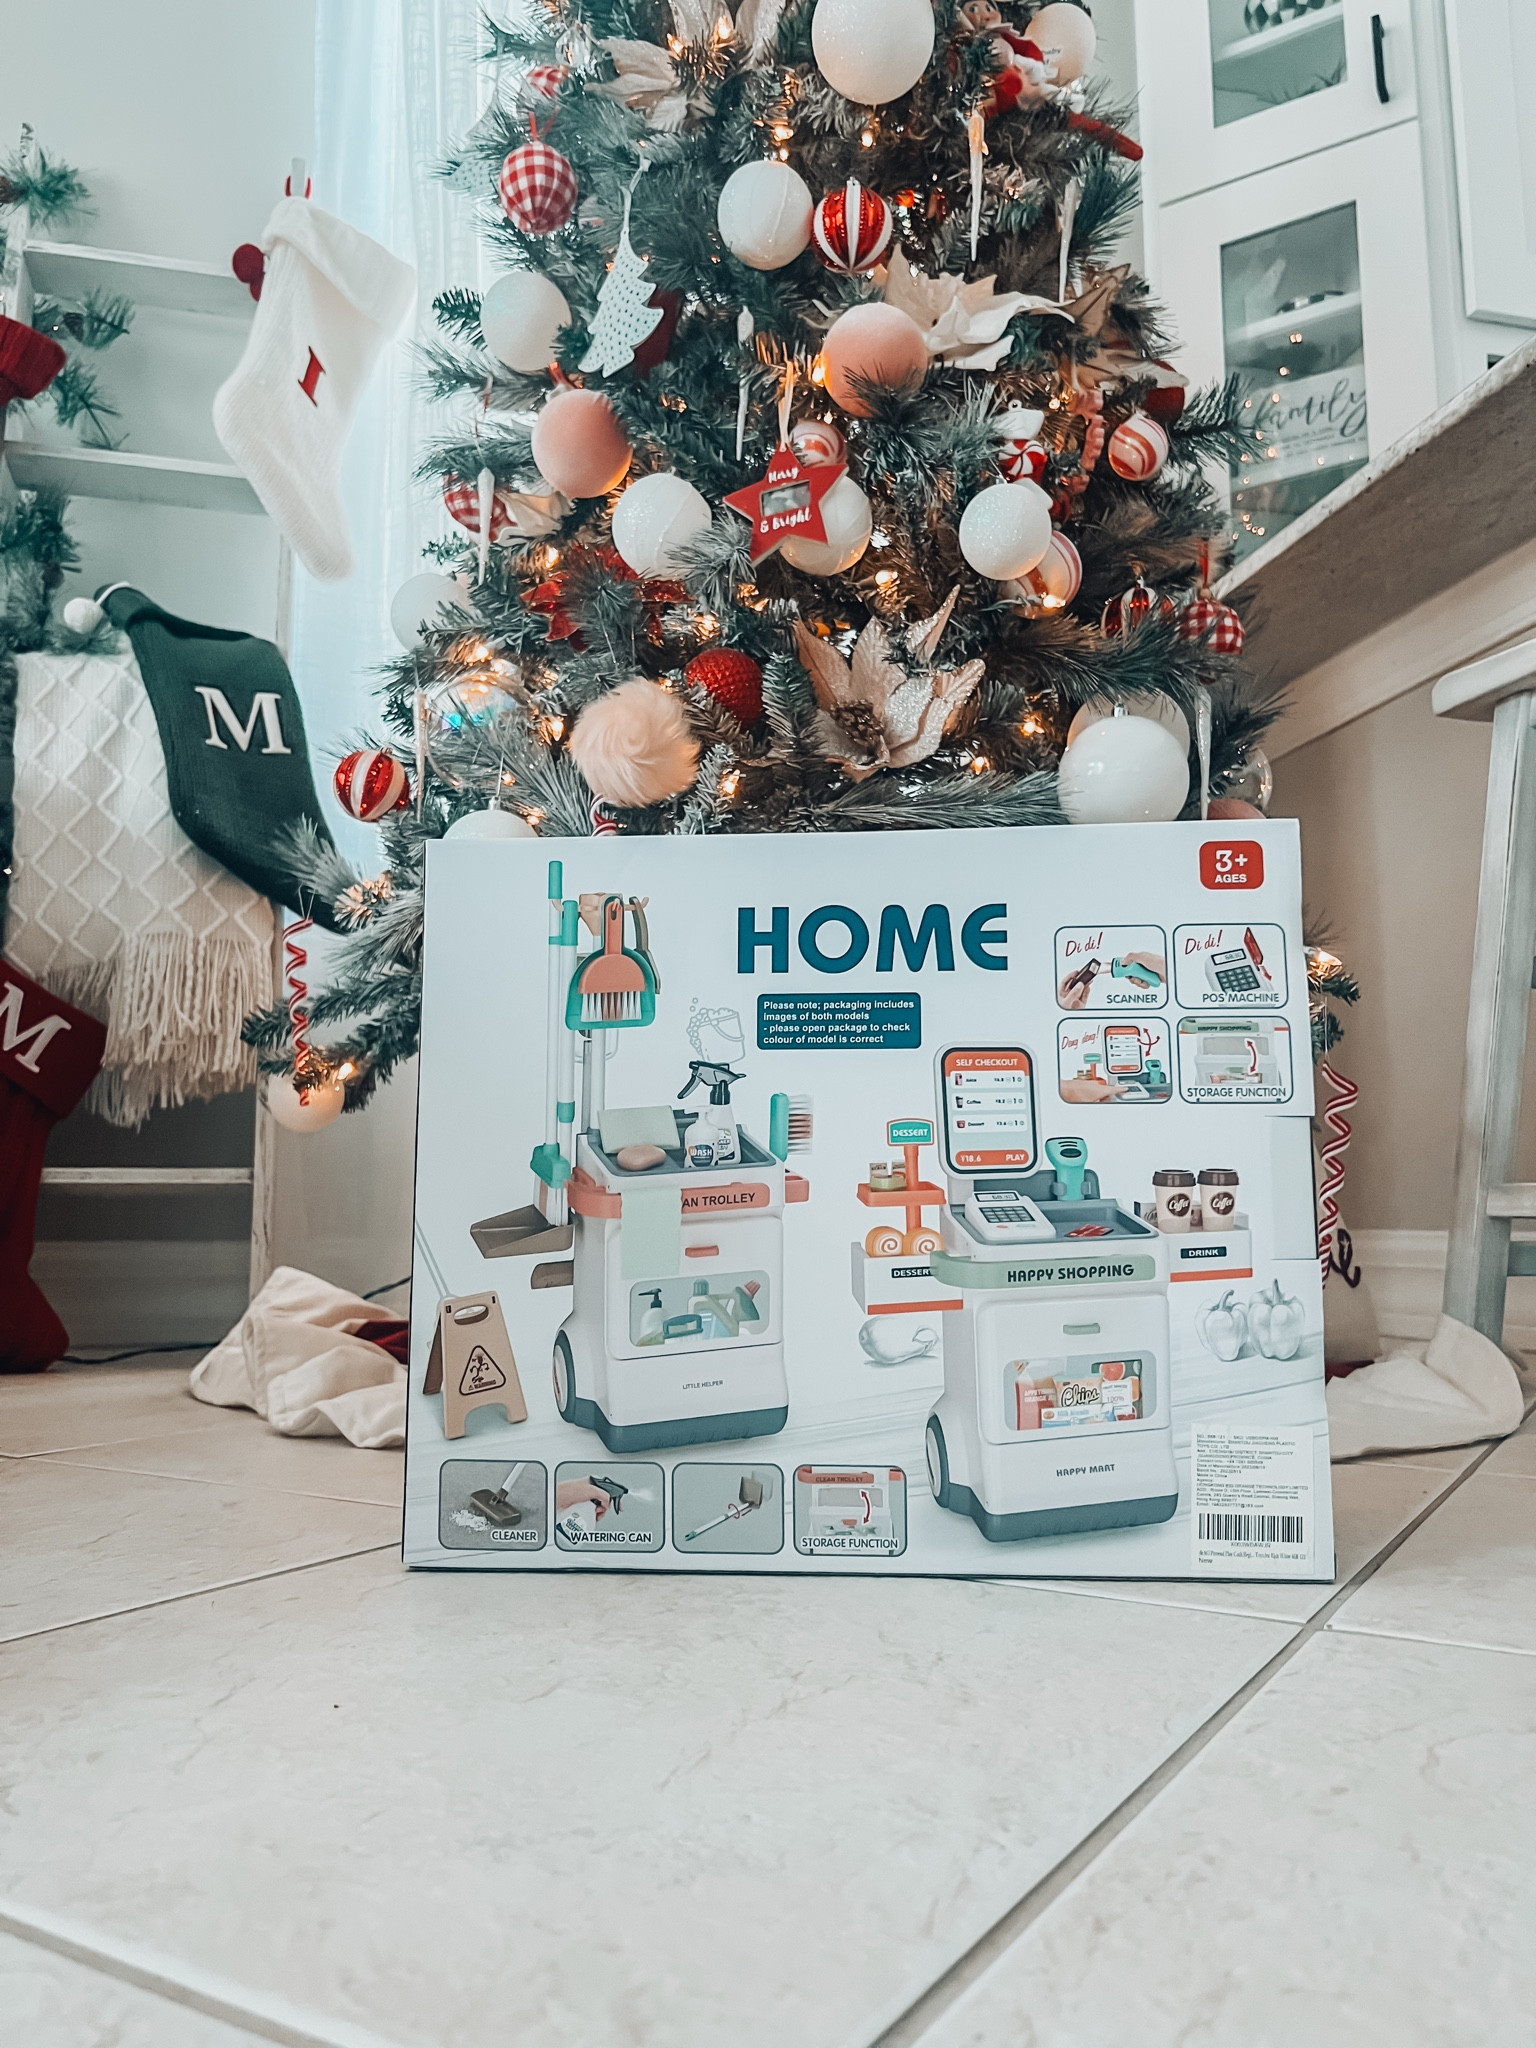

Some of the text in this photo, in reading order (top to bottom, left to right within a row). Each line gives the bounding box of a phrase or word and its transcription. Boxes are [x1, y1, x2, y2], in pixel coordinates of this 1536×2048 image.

[768, 466, 800, 484] Merry
[772, 507, 812, 530] Bright
[195, 686, 291, 755] M
[1215, 849, 1248, 872] 3+
[1214, 874, 1247, 883] AGES
[737, 903, 1008, 973] HOME
[1065, 940, 1084, 957] Di
[1185, 938, 1202, 955] Di
[1106, 994, 1158, 1004] SCANNER
[1202, 992, 1280, 1003] POS MACHINE
[763, 1000, 914, 1011] Please note; packaging includes
[763, 1013, 797, 1022] images
[835, 1012, 870, 1020] models
[769, 1024, 799, 1033] please
[802, 1025, 826, 1033] open
[828, 1024, 868, 1033] package
[882, 1023, 910, 1031] check
[763, 1036, 793, 1044] colour
[808, 1035, 837, 1043] model
[850, 1035, 884, 1043] correct
[956, 1058, 1018, 1066] SELF CHECKOUT
[1187, 1087, 1286, 1097] STORAGE FUNCTION
[892, 1128, 929, 1137] DESSERT
[1005, 1153, 1025, 1161] PLAY
[702, 1192, 756, 1206] TROLLEY
[1188, 1248, 1219, 1257] DRINK
[1007, 1264, 1135, 1283] HAPPY SHOPPING
[682, 1380, 724, 1390] LITTLE HELPER
[1061, 1383, 1100, 1407] Chips
[1056, 1463, 1115, 1477] HAPPY MART
[491, 1531, 537, 1541] CLEANER
[570, 1532, 652, 1543] WATERING CAN
[802, 1537, 898, 1548] STORAGE FUNCTION
